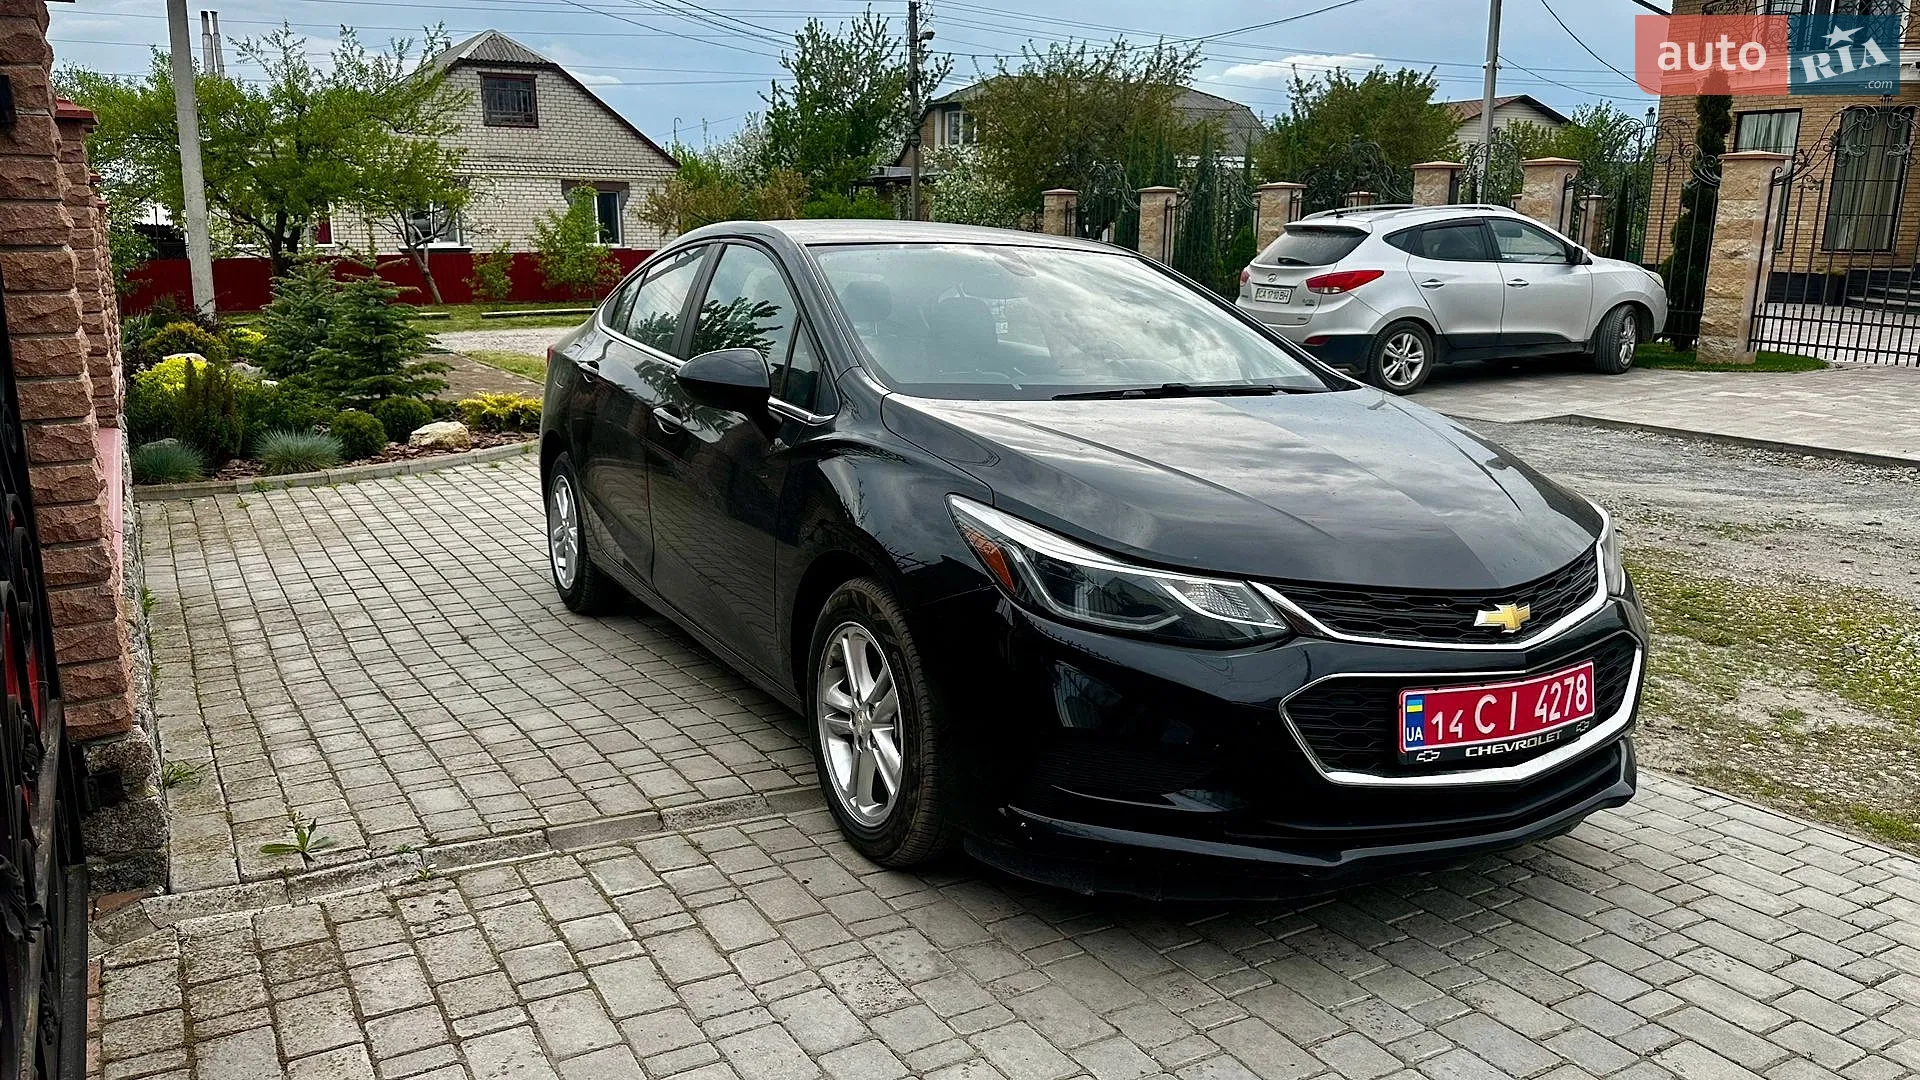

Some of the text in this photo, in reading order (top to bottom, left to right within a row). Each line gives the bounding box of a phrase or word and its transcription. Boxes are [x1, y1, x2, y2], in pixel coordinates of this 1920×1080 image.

[1431, 709, 1464, 741] 14
[1534, 673, 1588, 724] 4278
[1406, 727, 1424, 742] UA
[1465, 730, 1563, 758] CHEVROLET
